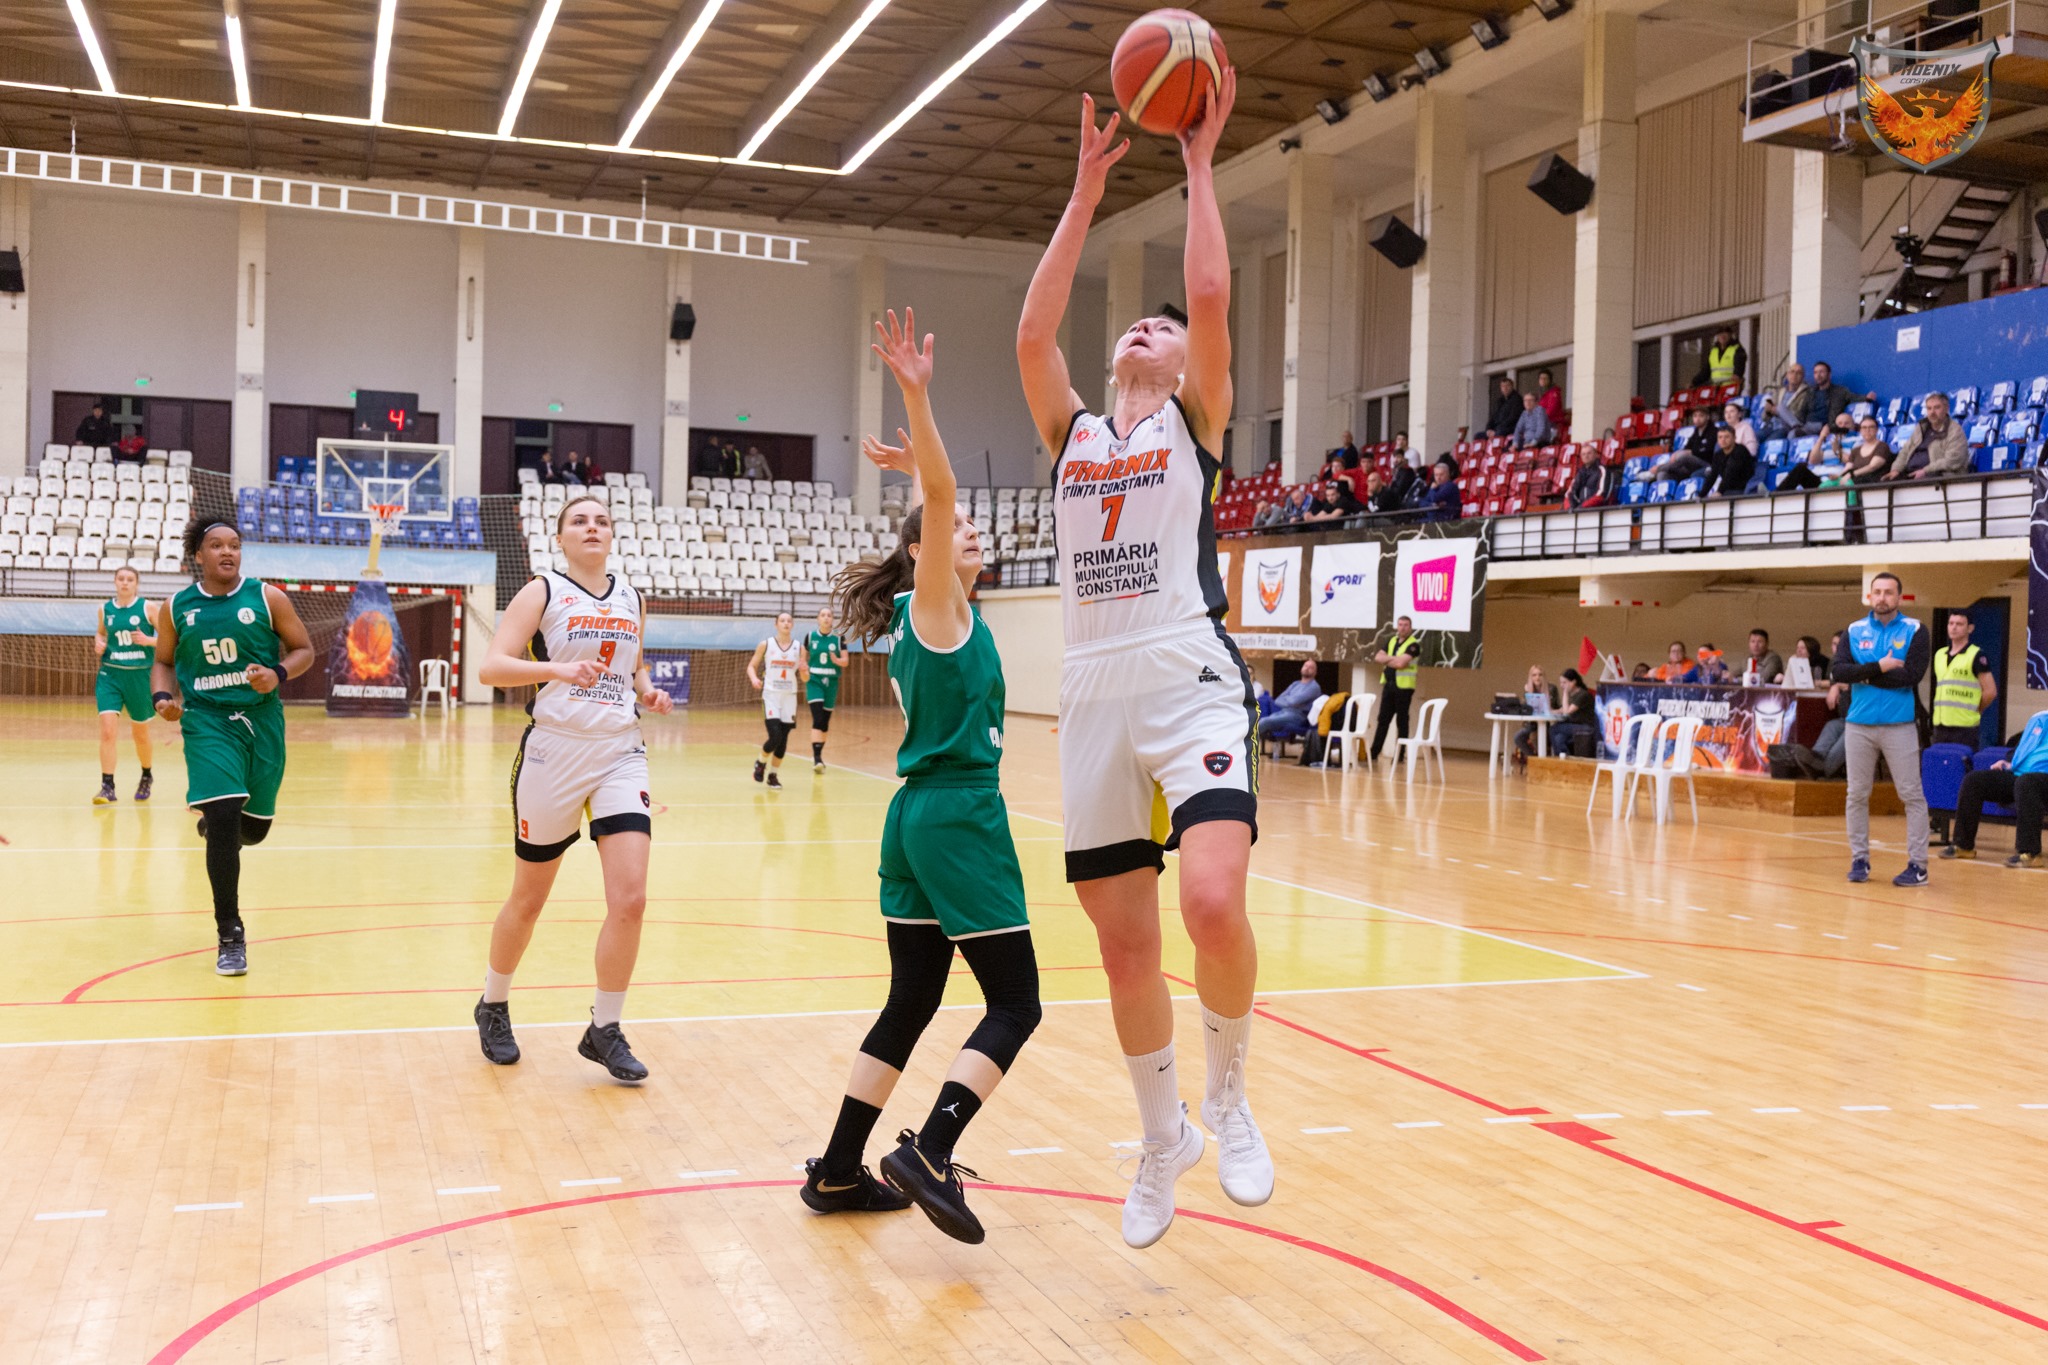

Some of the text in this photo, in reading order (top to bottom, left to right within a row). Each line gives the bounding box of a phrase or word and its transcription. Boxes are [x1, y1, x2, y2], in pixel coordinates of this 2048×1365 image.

[388, 408, 405, 431] 4
[1062, 448, 1173, 485] PHOENIX
[1101, 494, 1126, 543] 7
[1073, 541, 1159, 569] PRIMĂRIA
[1077, 573, 1158, 598] CONSTANȚA
[1416, 571, 1448, 602] VIVO!
[114, 629, 133, 646] 10
[202, 637, 238, 665] 50
[597, 640, 617, 668] 9
[521, 818, 529, 840] 9
